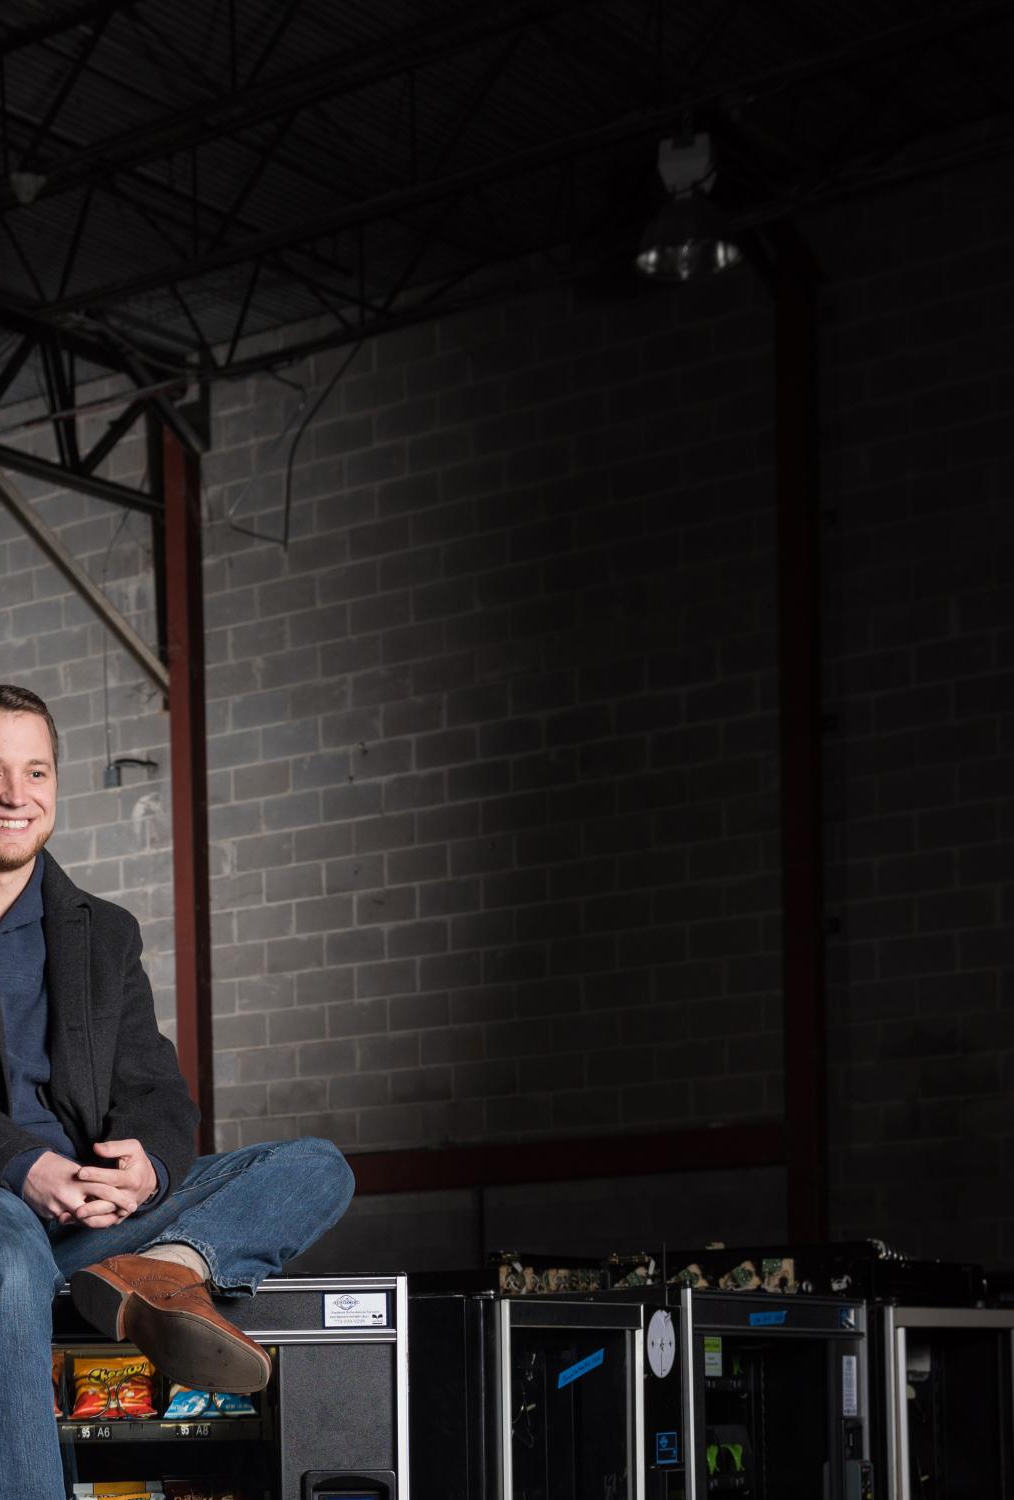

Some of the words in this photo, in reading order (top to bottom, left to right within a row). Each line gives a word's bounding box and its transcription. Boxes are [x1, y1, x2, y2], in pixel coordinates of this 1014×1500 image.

[78, 1426, 91, 1439] .95
[97, 1426, 111, 1438] A6
[176, 1424, 190, 1437] .95
[195, 1425, 209, 1437] A8
